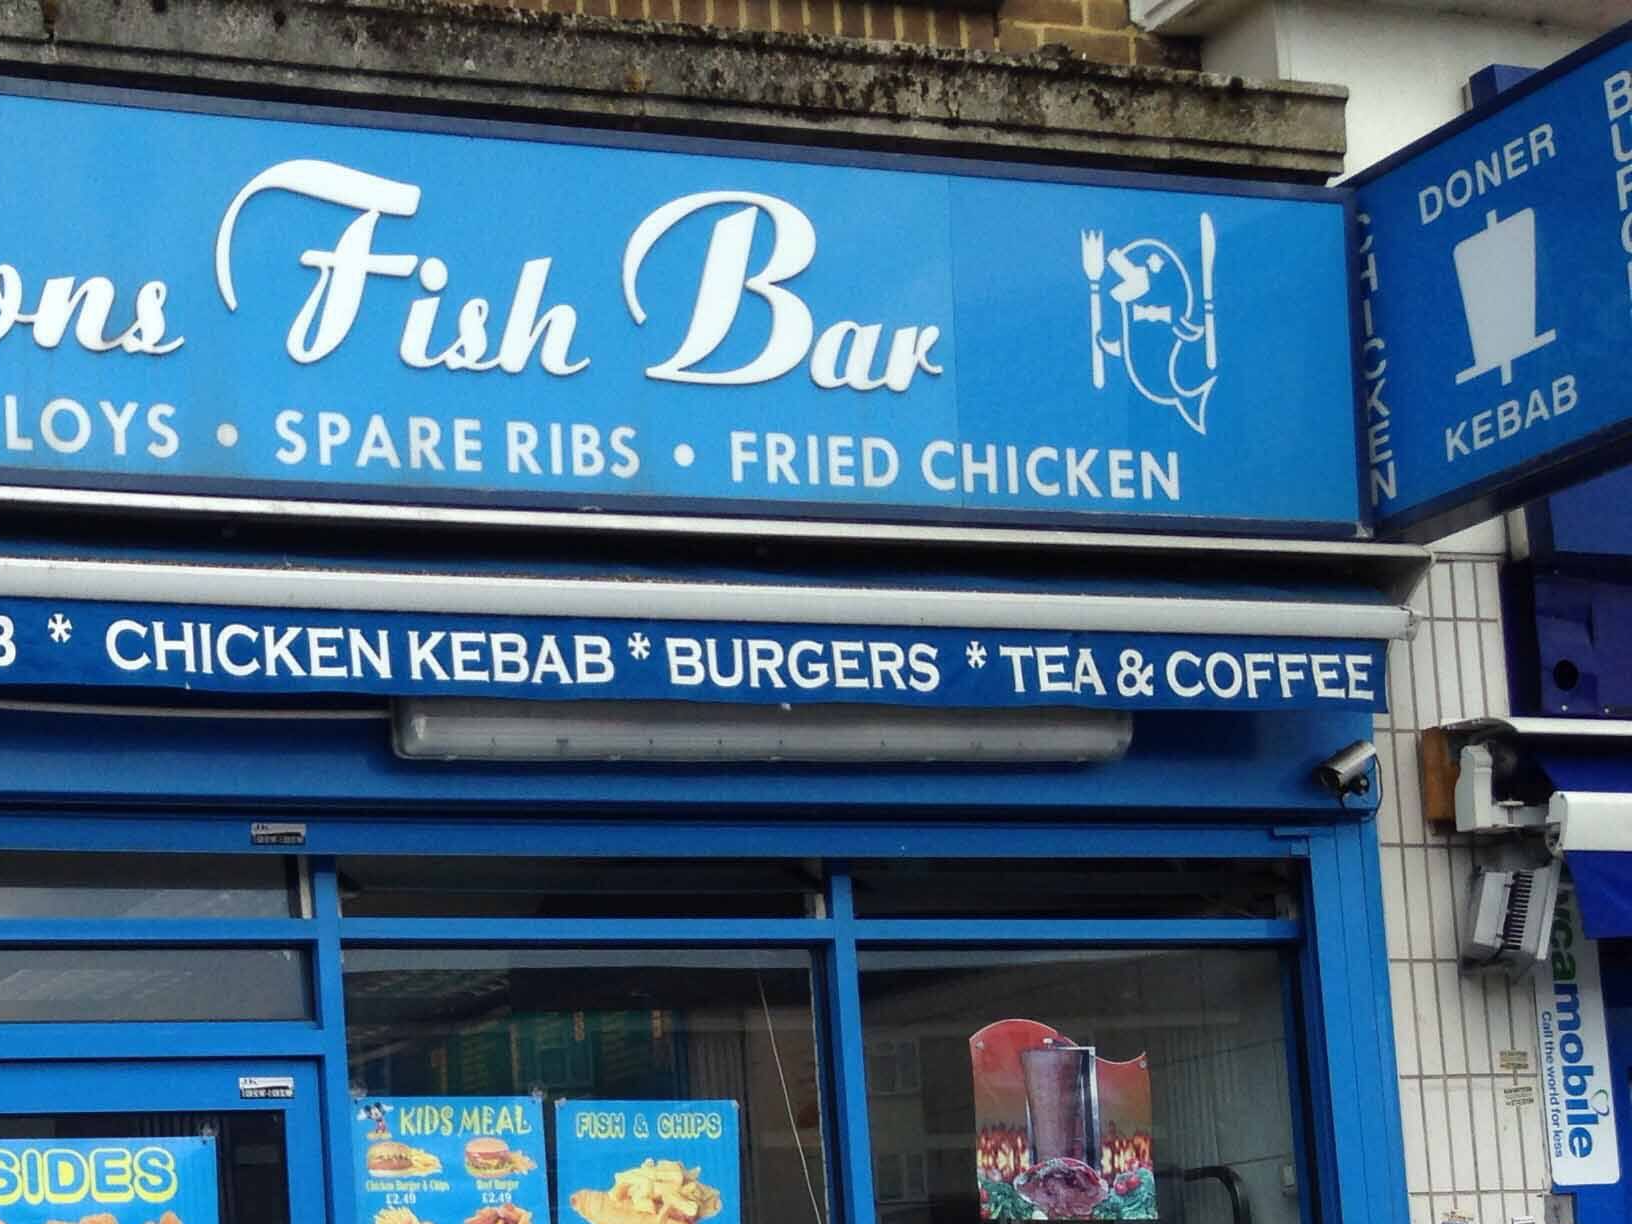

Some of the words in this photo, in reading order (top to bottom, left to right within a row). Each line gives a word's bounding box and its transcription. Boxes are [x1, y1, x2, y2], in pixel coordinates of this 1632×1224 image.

[1417, 122, 1557, 225] DONER
[215, 158, 589, 376] Fish
[622, 189, 942, 392] Bar
[275, 409, 483, 473] SPARE
[507, 421, 640, 478] RIBS
[730, 431, 898, 488] FRIED
[921, 441, 1181, 500] CHICKEN
[1444, 374, 1579, 462] KEBAB
[105, 618, 392, 681] CHICKEN
[408, 630, 615, 684] KEBAB
[668, 637, 939, 693] BURGERS
[1002, 644, 1106, 696] TEA
[1117, 649, 1155, 696] &
[1166, 650, 1374, 700] COFFEE
[400, 1106, 453, 1136] KIDS
[457, 1105, 531, 1136] MEAL
[575, 1112, 625, 1138] FISH
[633, 1112, 649, 1138] &
[657, 1113, 722, 1139] CHIPS
